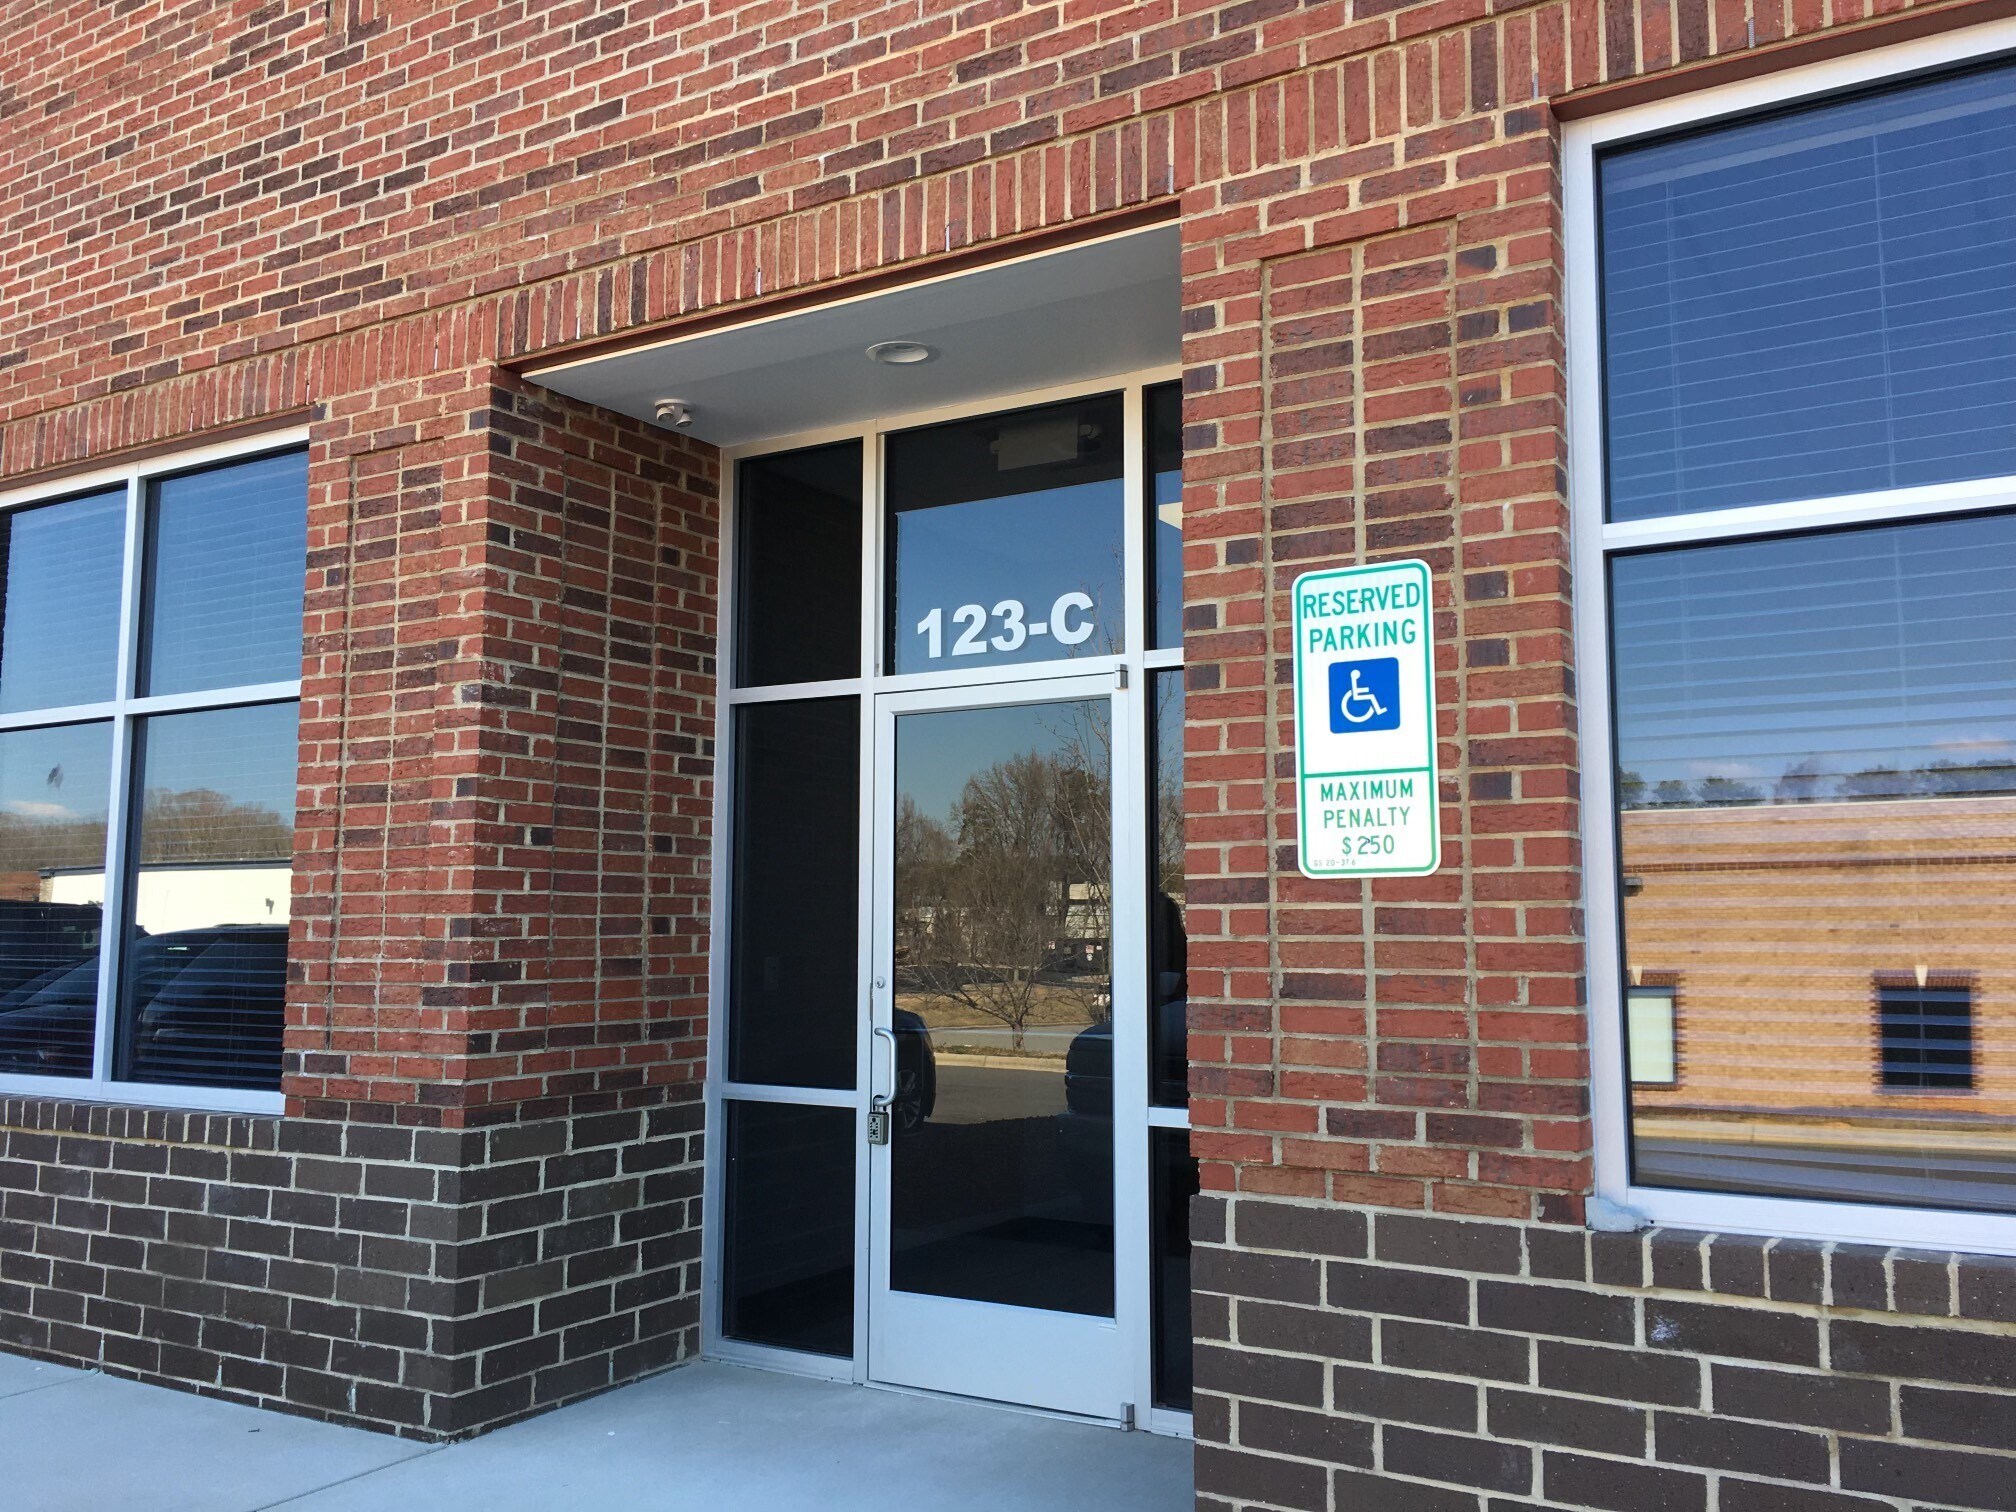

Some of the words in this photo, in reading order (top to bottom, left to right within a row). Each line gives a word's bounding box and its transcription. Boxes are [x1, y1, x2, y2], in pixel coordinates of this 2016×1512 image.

[1303, 582, 1420, 619] RESERVED
[917, 592, 1094, 659] 123-C
[1309, 619, 1416, 653] PARKING
[1320, 778, 1413, 802] MAXIMUM
[1323, 806, 1410, 829] PENALTY
[1342, 834, 1395, 857] $250
